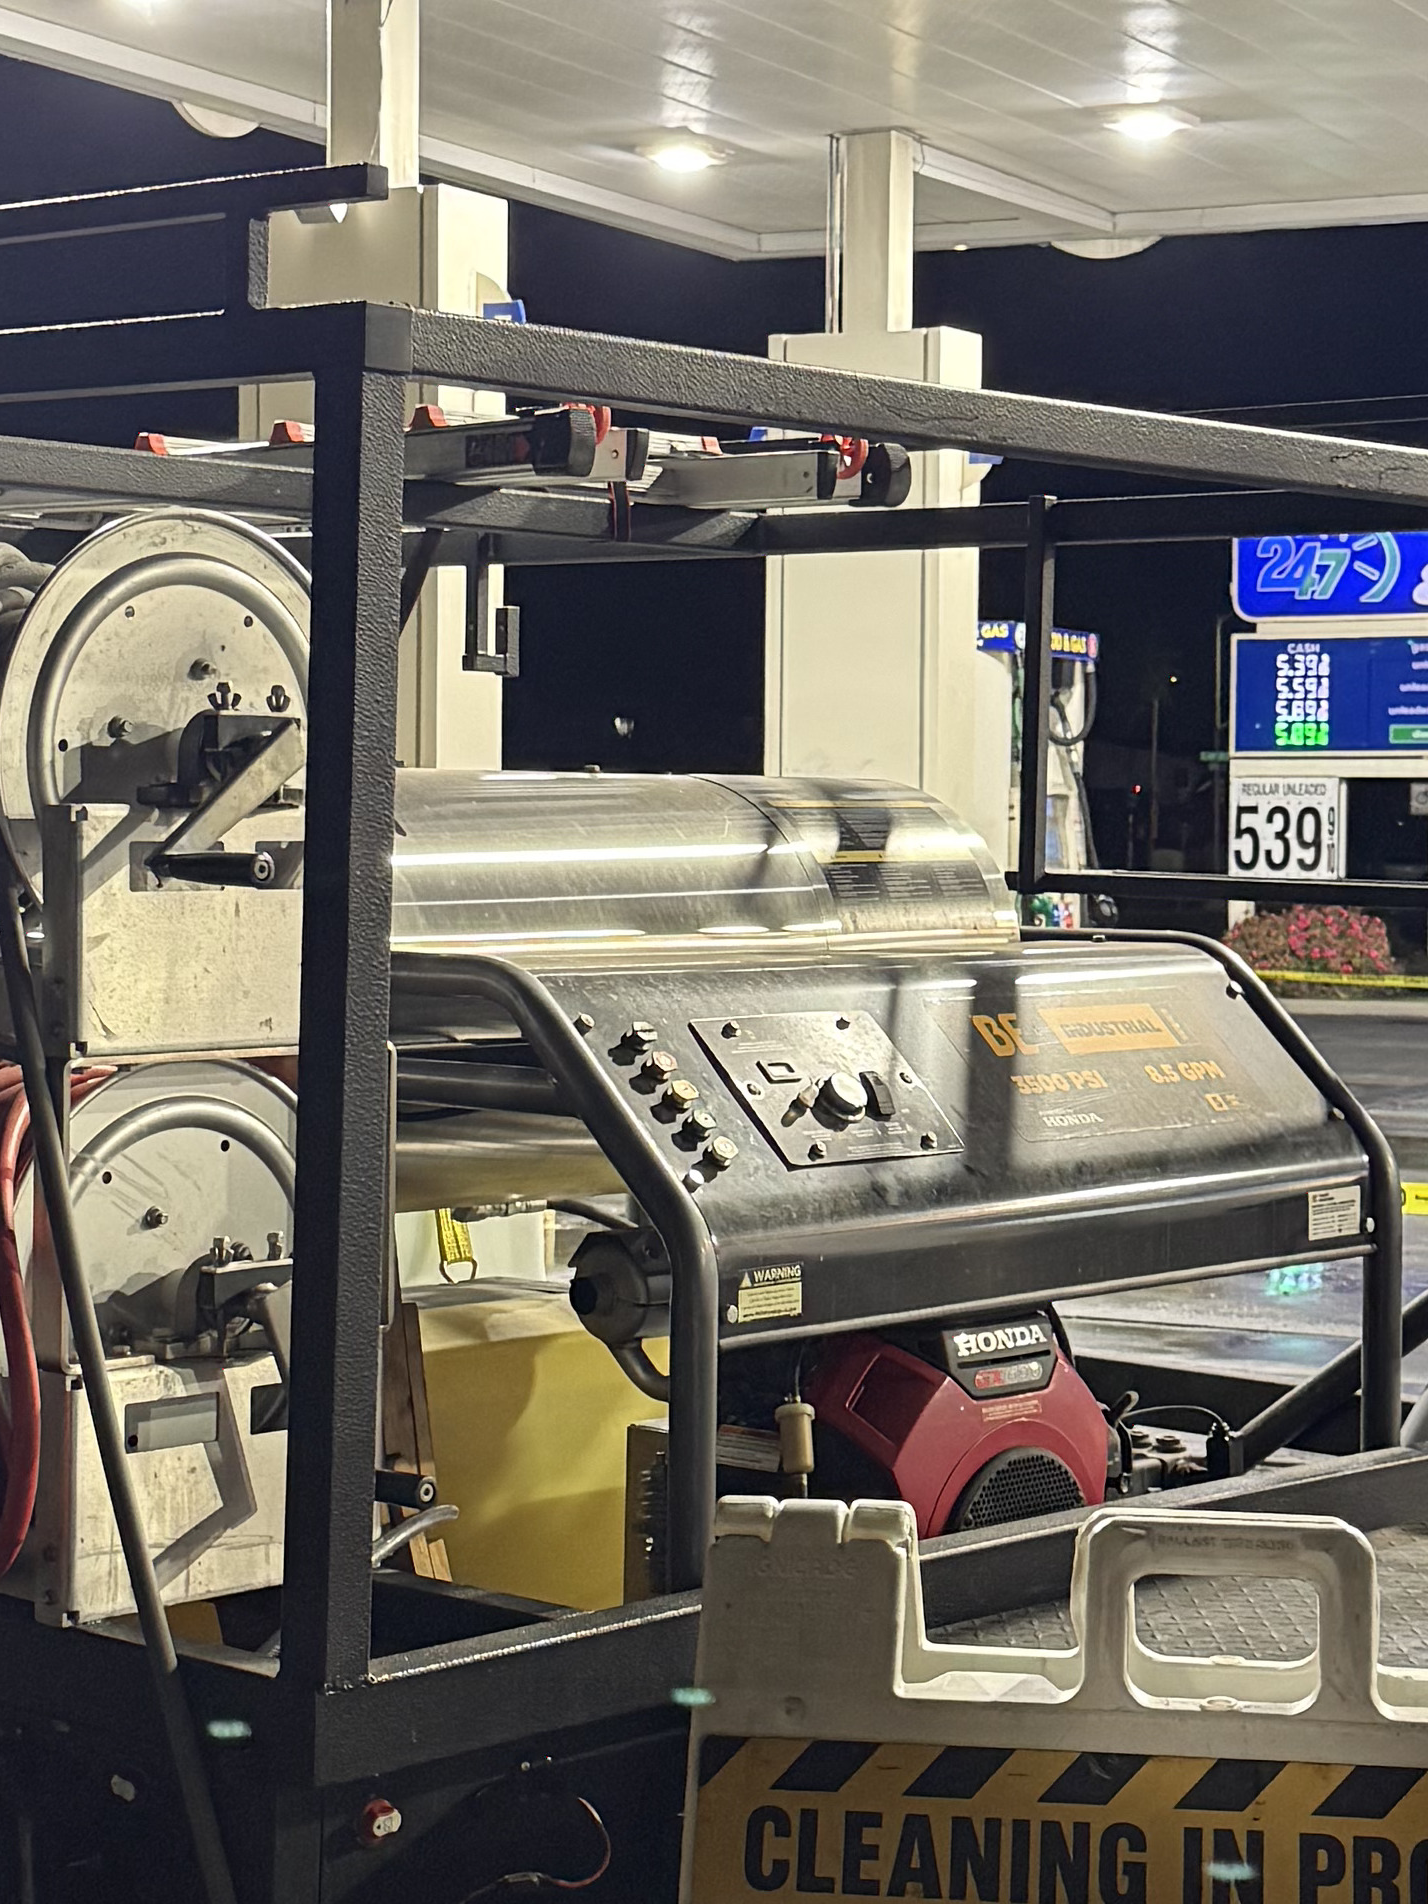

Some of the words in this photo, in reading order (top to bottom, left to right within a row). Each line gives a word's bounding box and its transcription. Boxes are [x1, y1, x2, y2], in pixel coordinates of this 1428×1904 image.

[1241, 783, 1280, 797] REGULAR
[1282, 783, 1327, 797] UNLEADED
[1233, 805, 1323, 873] 539
[1010, 1072, 1069, 1096] 3500
[1068, 1069, 1109, 1091] PSI
[1144, 1062, 1181, 1085] 8.5
[1178, 1060, 1226, 1082] GPM
[1042, 1112, 1105, 1128] HONDA
[753, 1264, 802, 1283] WARNING
[954, 1324, 1048, 1357] HONDA
